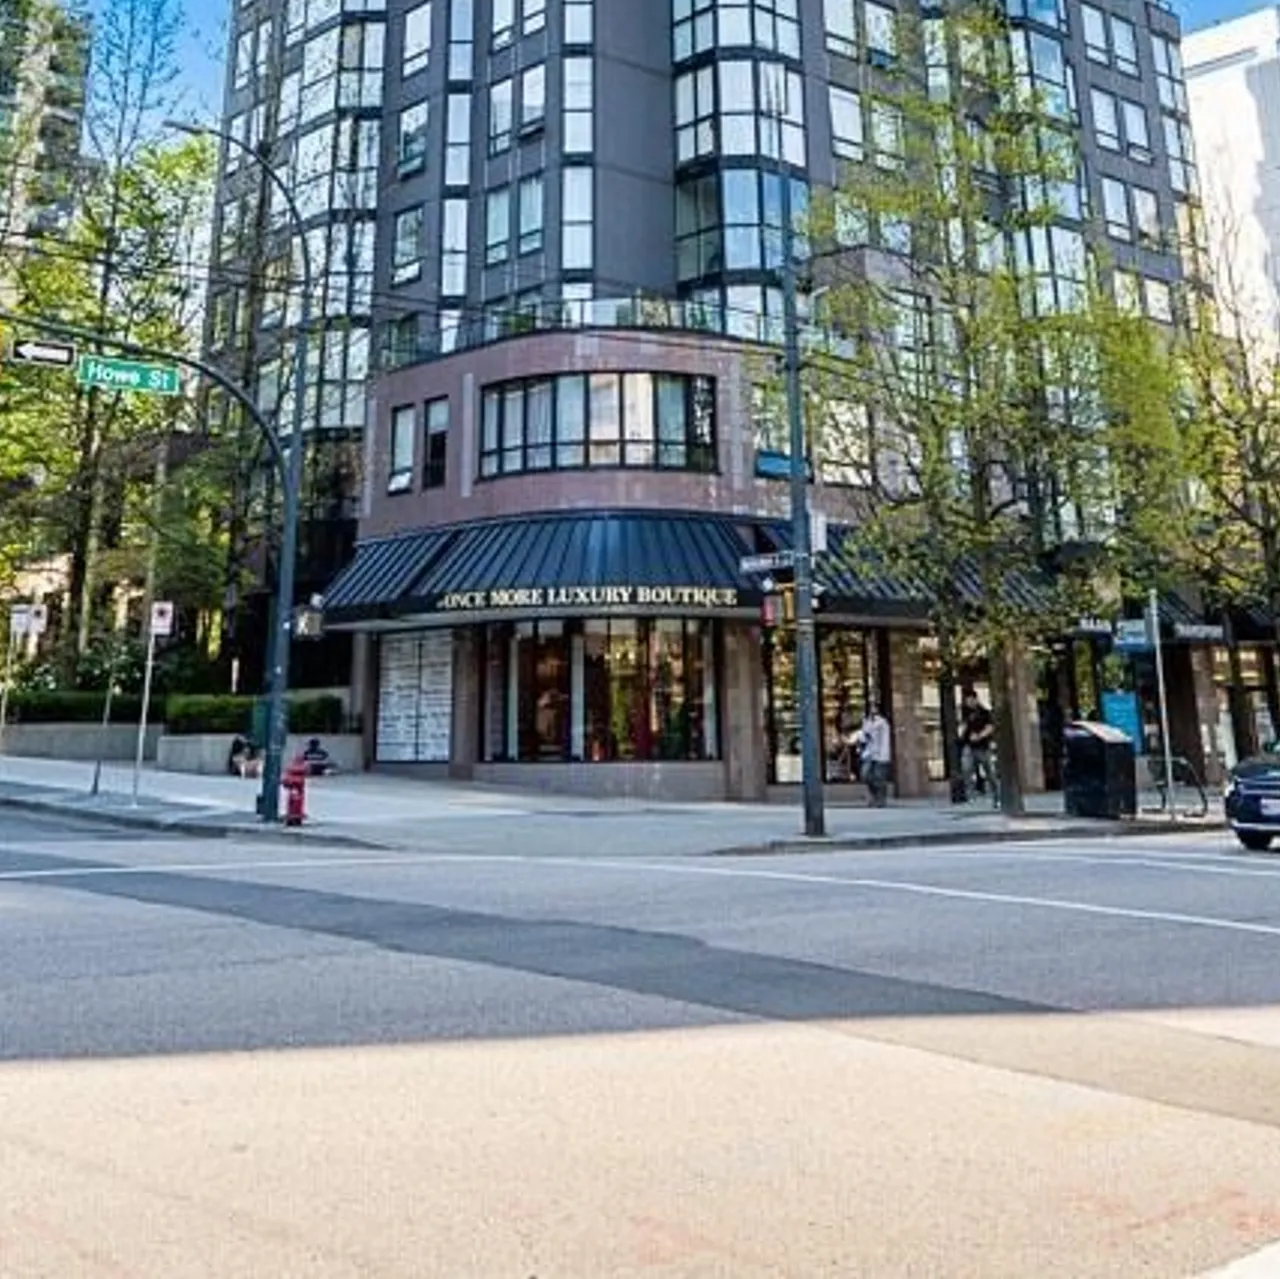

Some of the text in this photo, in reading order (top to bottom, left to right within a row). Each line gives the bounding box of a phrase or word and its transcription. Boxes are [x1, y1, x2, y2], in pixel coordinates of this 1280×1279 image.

[87, 361, 170, 389] Howe St
[489, 588, 544, 606] MORE
[547, 586, 633, 605] LUXURY
[637, 586, 738, 607] BOUTIQUE
